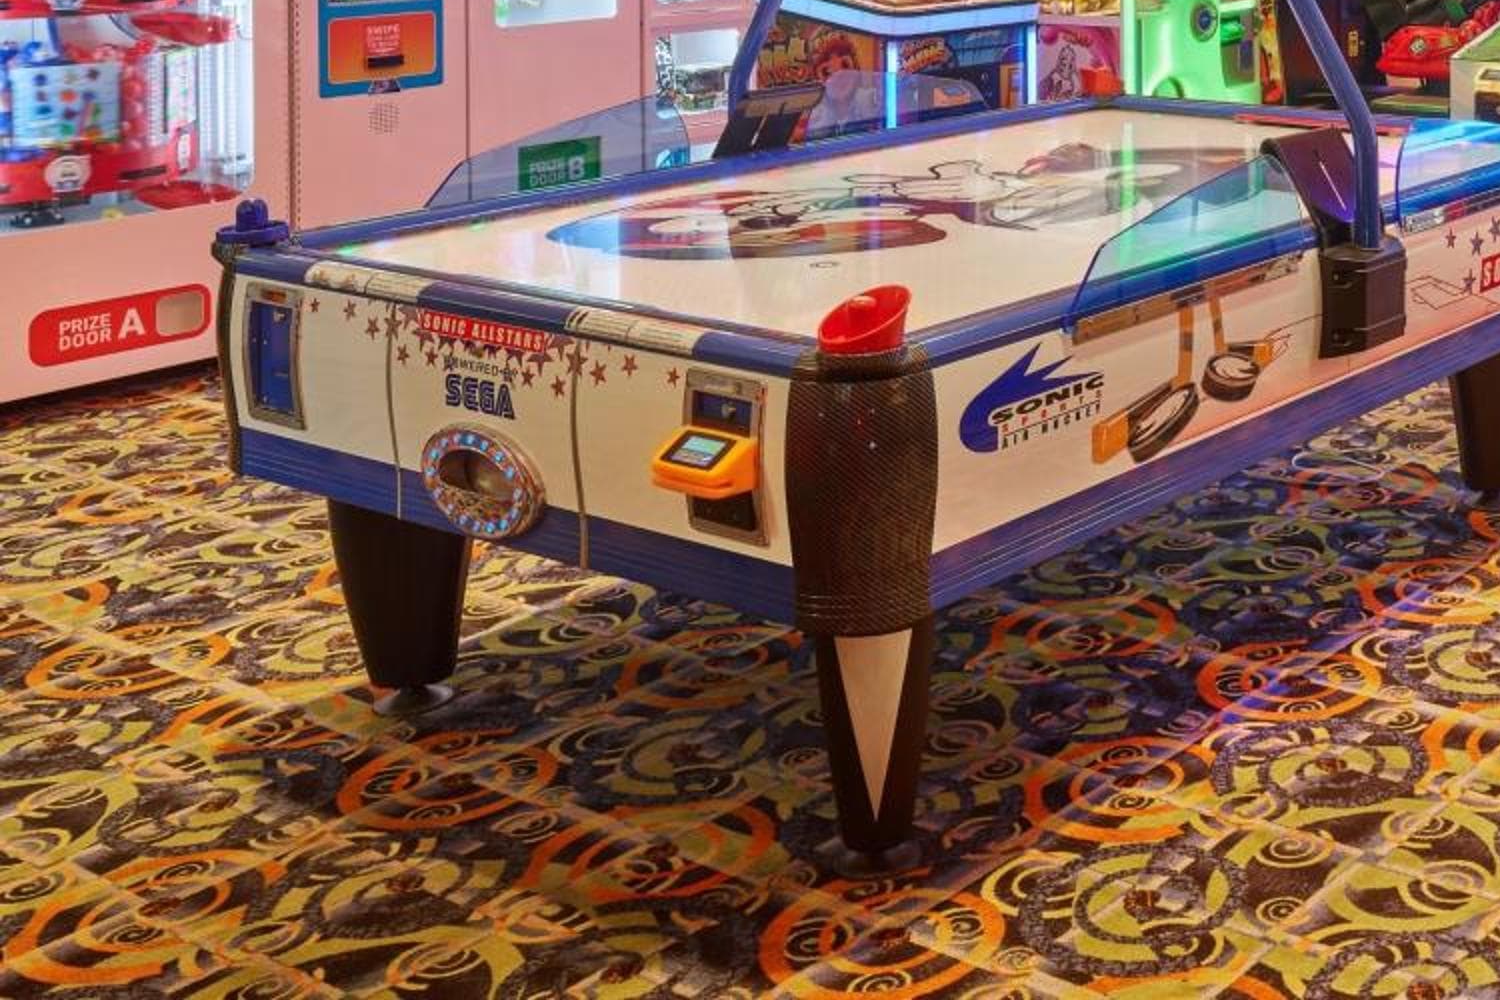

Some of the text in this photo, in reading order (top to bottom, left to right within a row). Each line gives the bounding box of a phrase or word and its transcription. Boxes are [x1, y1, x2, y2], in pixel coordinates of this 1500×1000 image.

[59, 313, 112, 335] PRIZE
[59, 327, 112, 351] DOOR
[118, 307, 146, 339] A
[423, 313, 543, 350] SONIC ALLSTARS
[444, 355, 499, 376] POWERED
[445, 373, 515, 420] SEGA
[992, 374, 1105, 425] SONIC
